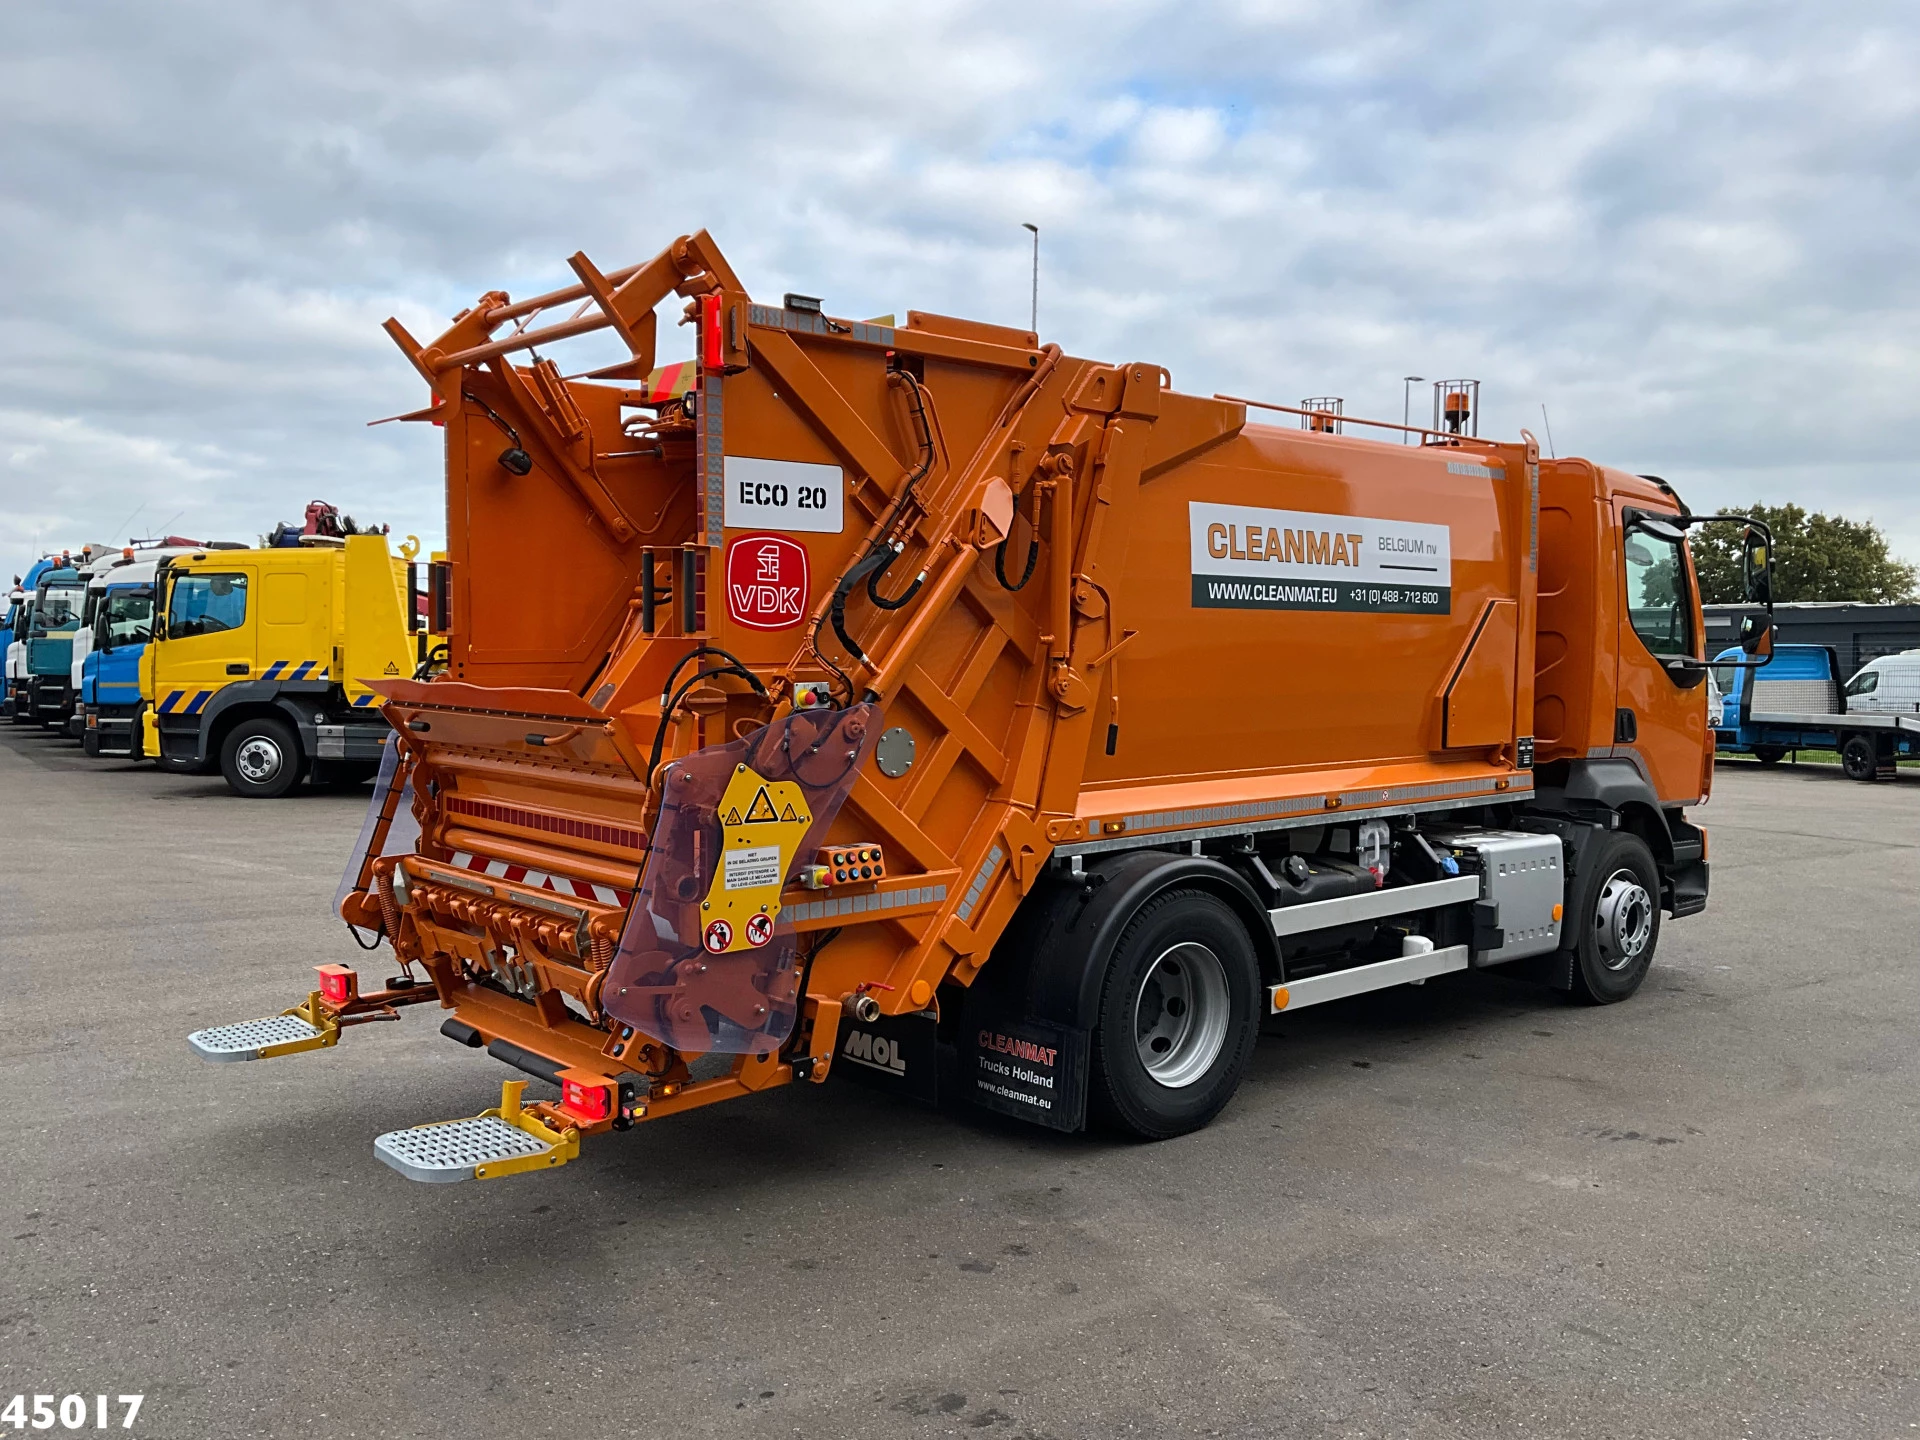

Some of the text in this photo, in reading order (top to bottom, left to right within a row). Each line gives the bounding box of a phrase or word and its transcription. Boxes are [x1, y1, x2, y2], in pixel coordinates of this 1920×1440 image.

[740, 482, 827, 509] ECO 20
[1207, 522, 1437, 567] CLEANMAT BELGIUM nv
[732, 584, 800, 615] VDK
[1208, 582, 1338, 603] WWW.CLEANMAT.EU
[1349, 589, 1367, 602] +31
[1368, 589, 1381, 605] (0)
[1382, 590, 1399, 603] 488
[1404, 591, 1421, 604] 712
[1422, 592, 1439, 605] 600
[843, 1030, 906, 1071] MOL
[978, 1030, 1057, 1067] CLEANMAT
[978, 1055, 1054, 1089] Trucks Holland
[977, 1079, 1052, 1110] www.cleanmat.eu
